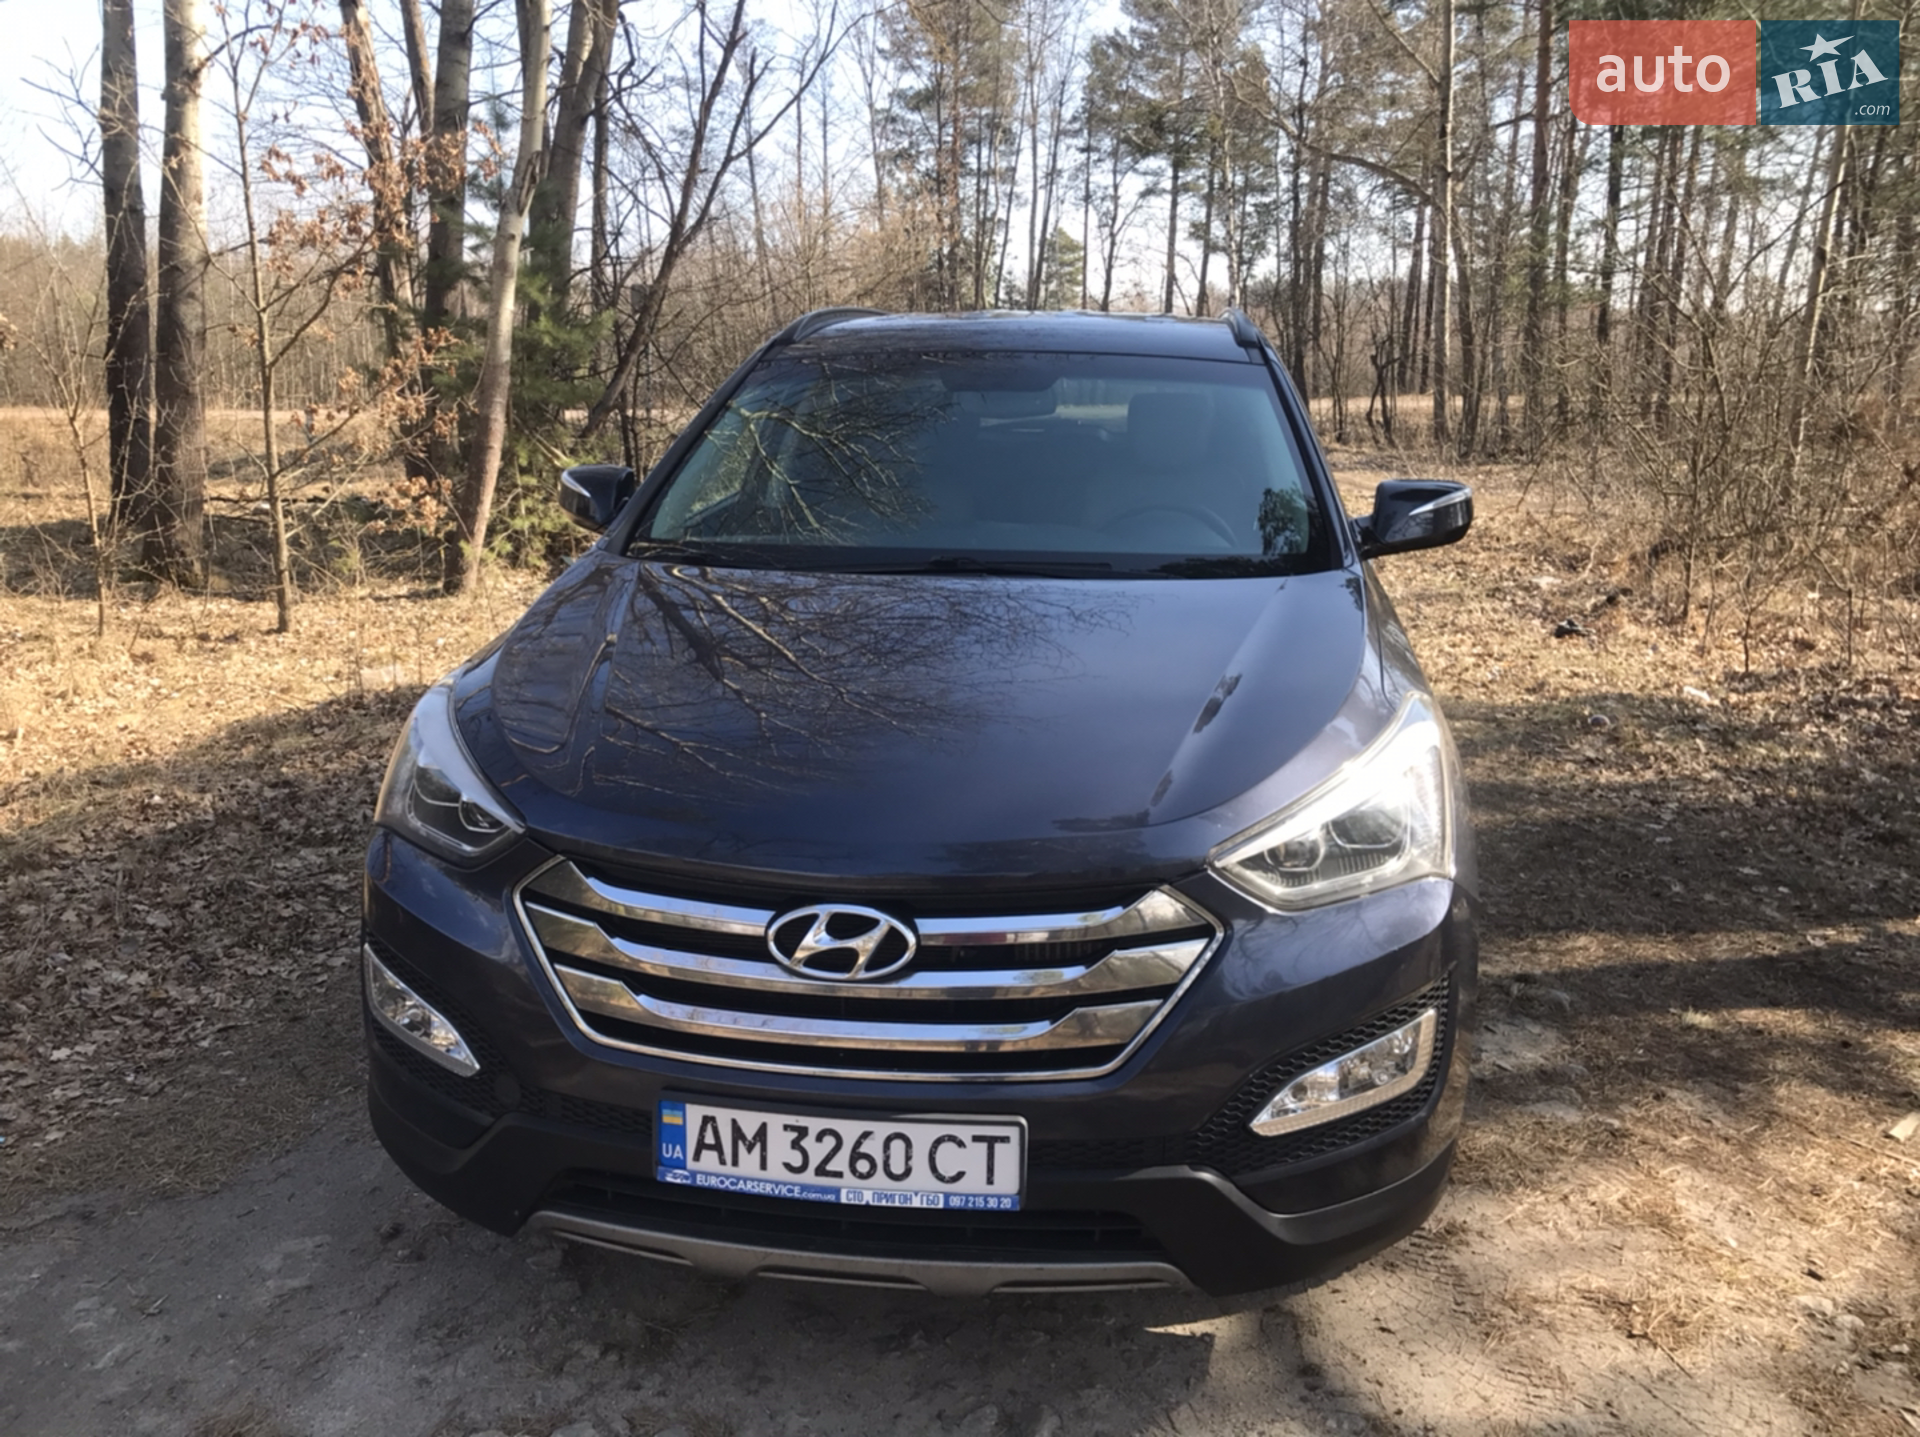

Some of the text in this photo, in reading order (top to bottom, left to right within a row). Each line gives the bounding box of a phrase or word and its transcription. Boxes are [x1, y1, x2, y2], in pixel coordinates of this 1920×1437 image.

[662, 1142, 684, 1160] UA
[692, 1114, 1011, 1186] AM 3260 CT
[949, 1195, 1012, 1209] 097 215 30 20
